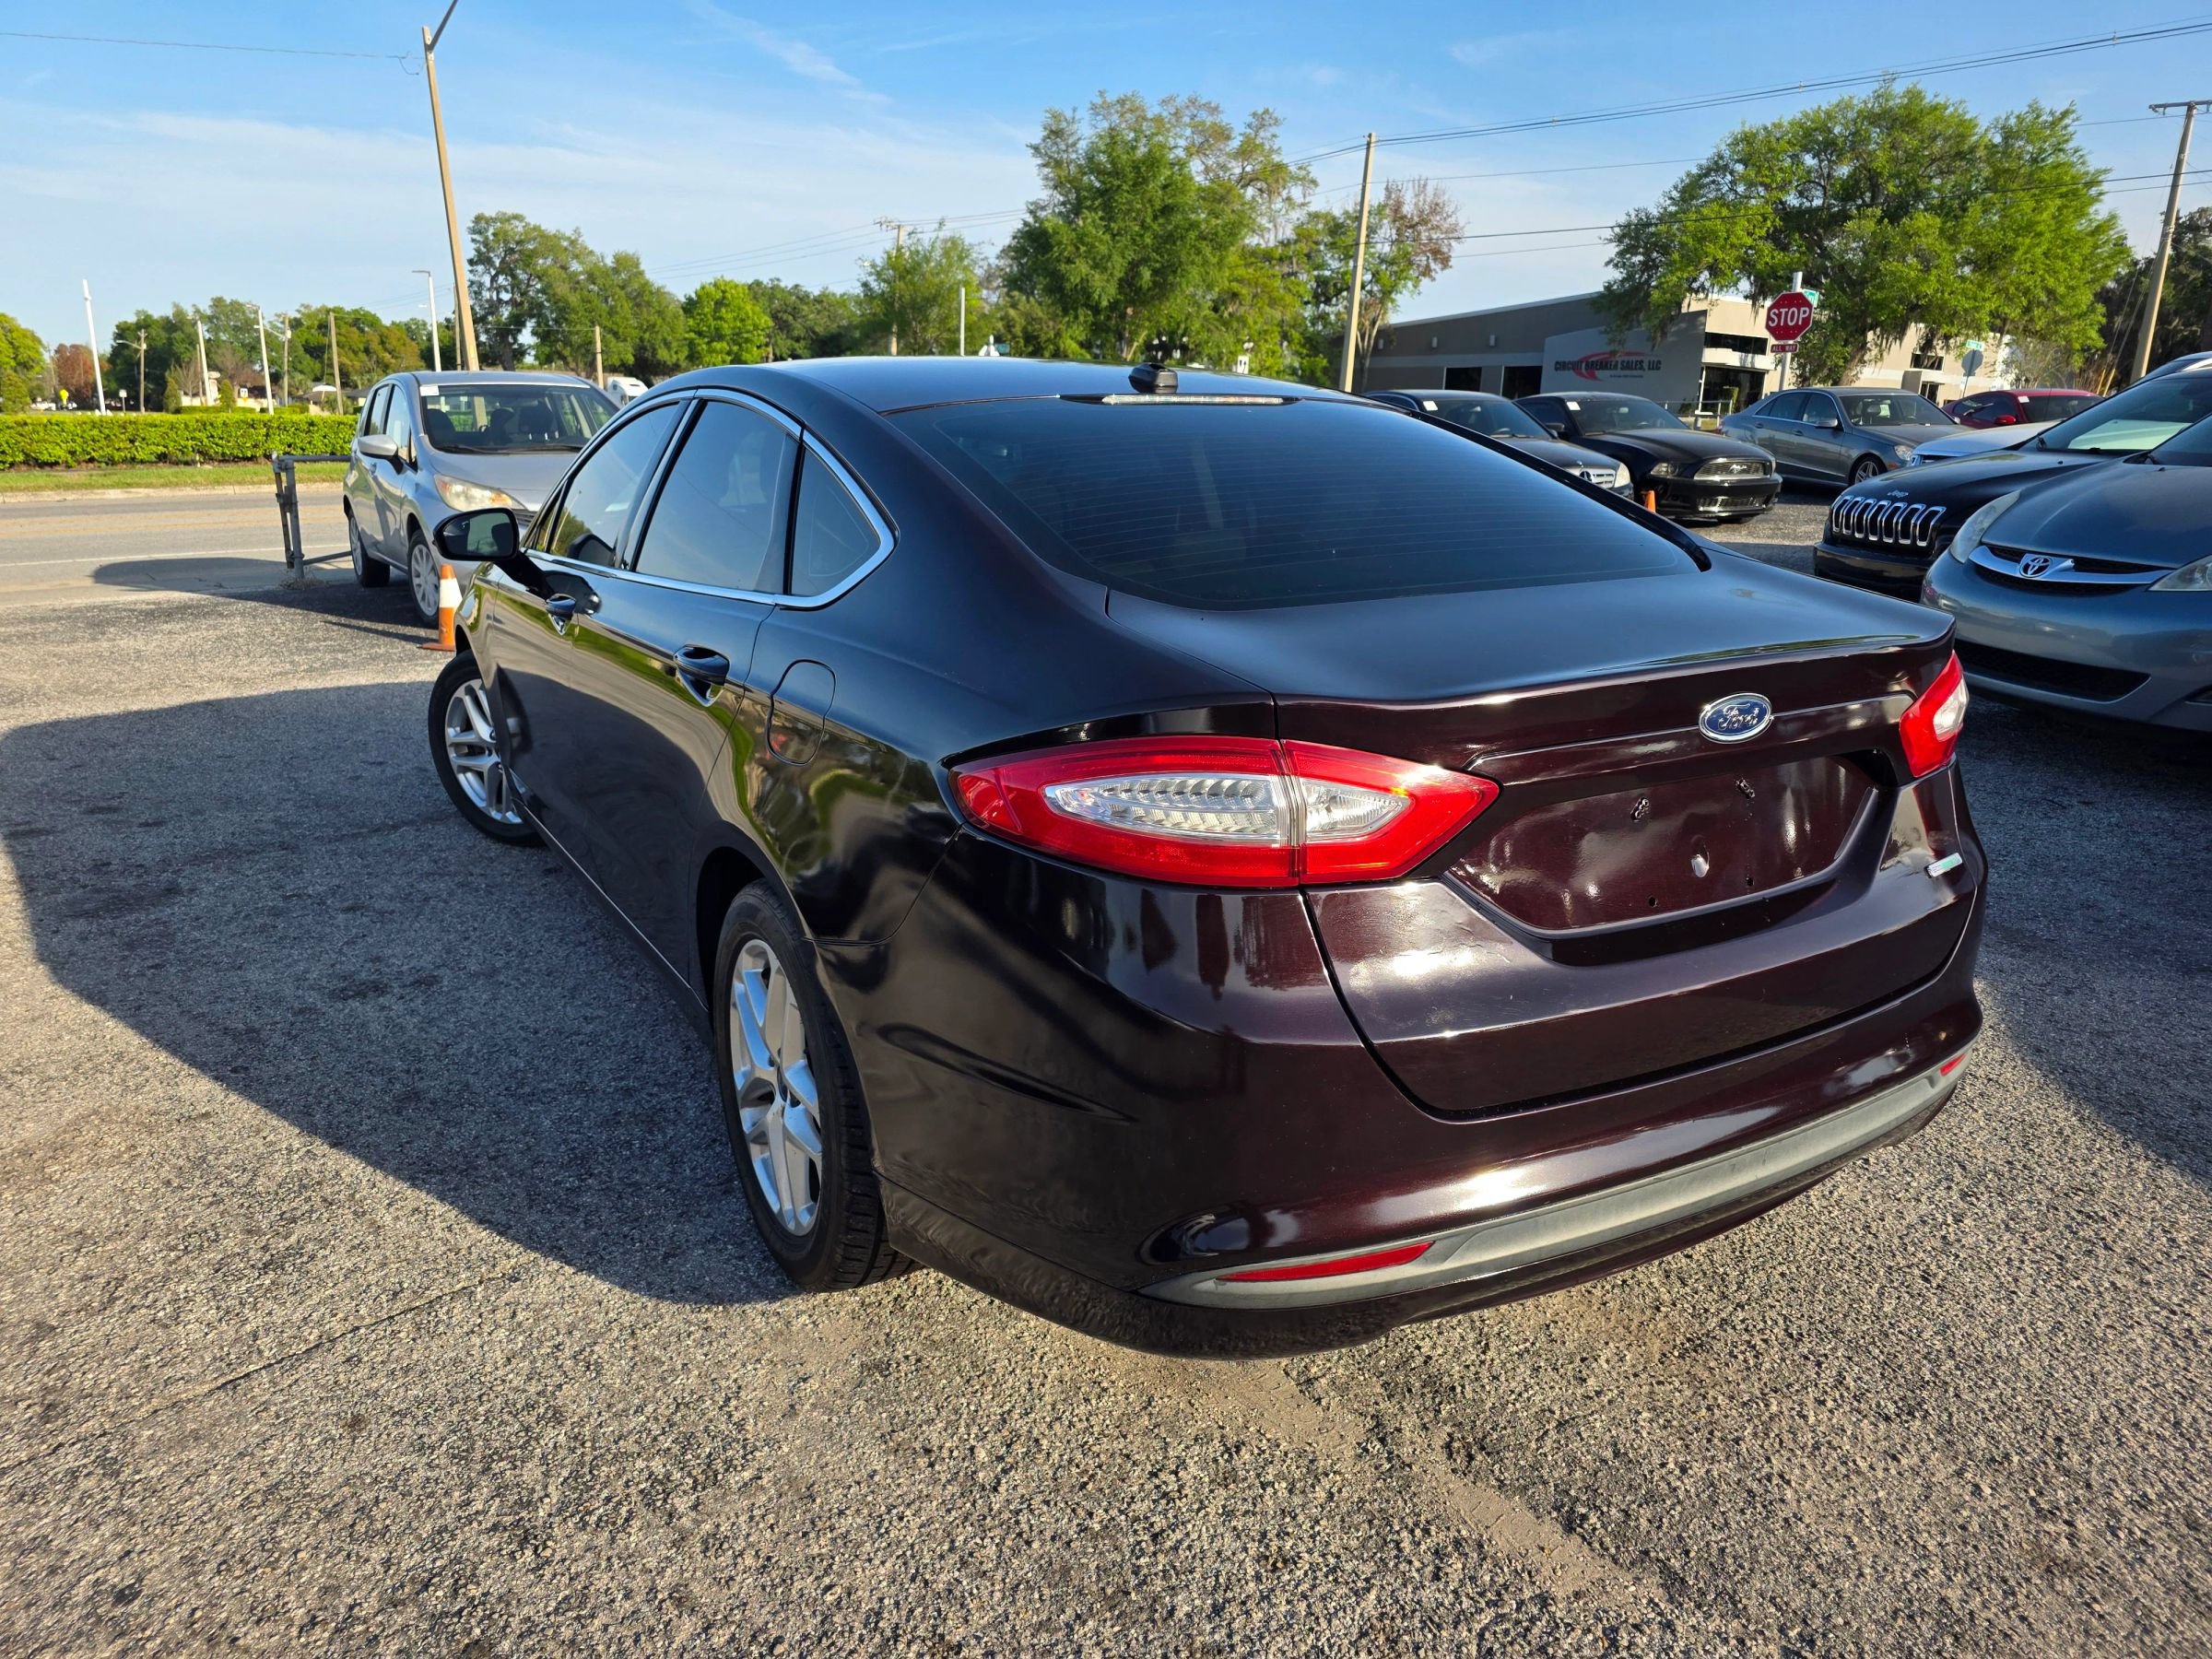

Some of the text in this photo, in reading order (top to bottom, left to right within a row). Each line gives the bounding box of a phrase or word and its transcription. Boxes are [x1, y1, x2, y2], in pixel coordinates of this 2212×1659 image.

[1769, 307, 1809, 326] STOP
[1554, 360, 1583, 371] CIRCUIT
[1620, 359, 1645, 371] SALES,
[1647, 359, 1663, 371] LLC
[1718, 703, 1759, 730] Ford
